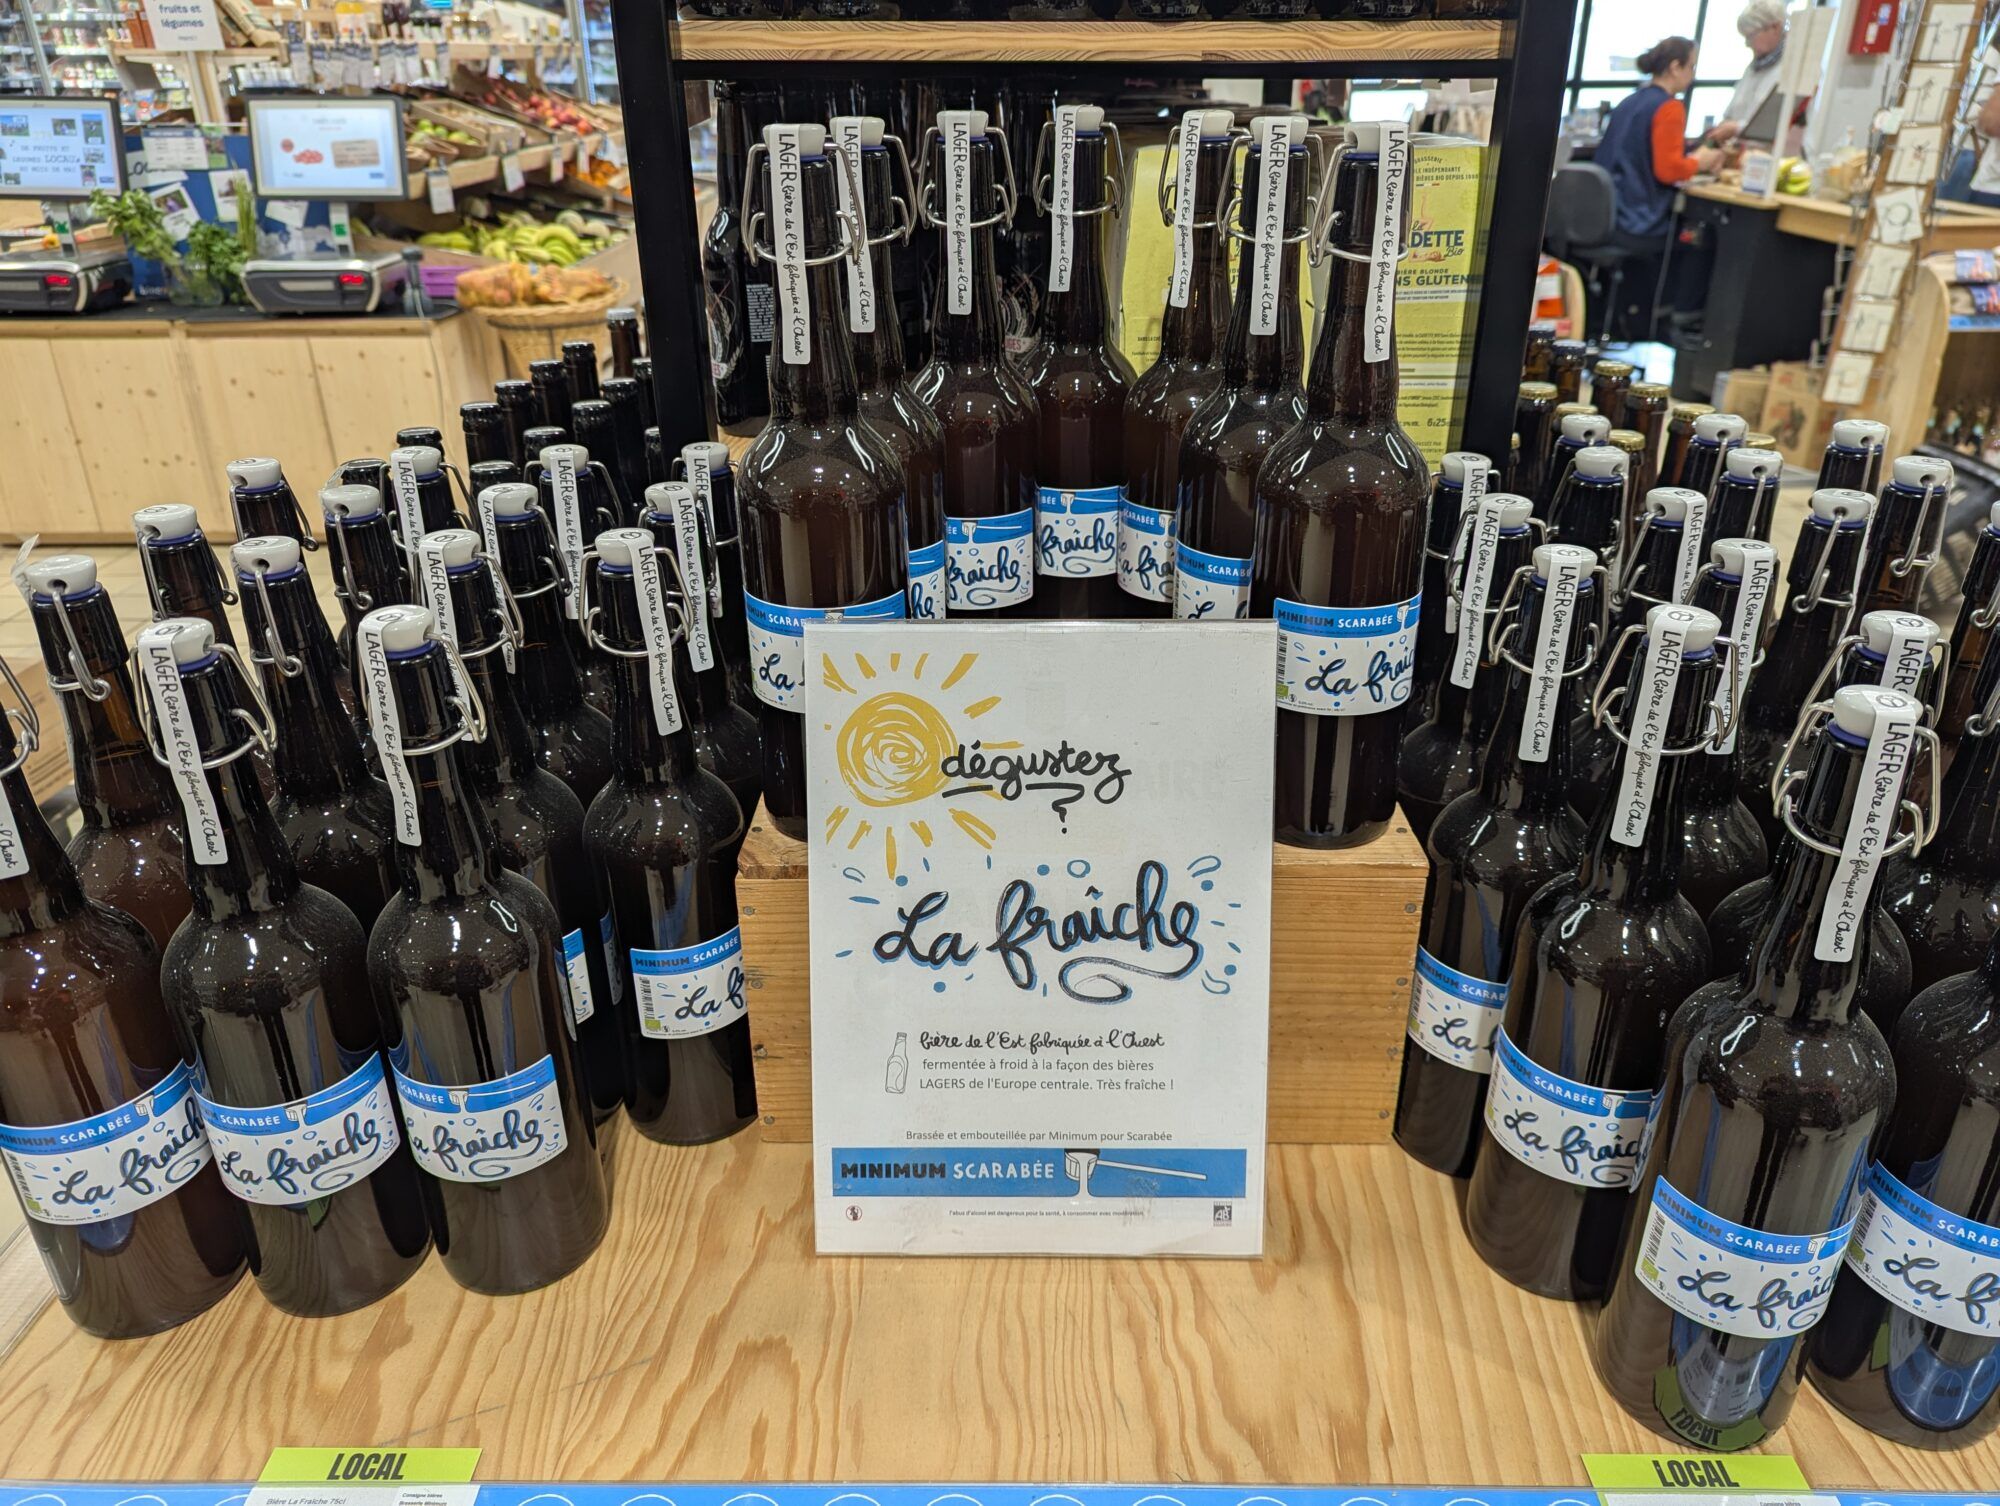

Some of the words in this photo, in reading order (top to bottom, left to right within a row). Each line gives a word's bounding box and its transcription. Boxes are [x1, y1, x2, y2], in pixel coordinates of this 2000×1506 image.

[953, 122, 967, 164] LAGER
[1061, 112, 1073, 152] LAGER
[1185, 118, 1200, 160] LAGER
[1268, 124, 1286, 172] LAGER
[779, 133, 796, 185] LAGER
[1386, 130, 1403, 181] LAGER
[781, 185, 794, 215] bière
[1385, 181, 1397, 212] bière
[784, 217, 794, 230] de
[1384, 215, 1392, 227] de
[1410, 230, 1465, 248] DETTE
[785, 233, 797, 261] l'Est
[1381, 230, 1393, 258] l'Est
[783, 264, 799, 304] fabriquée
[1374, 261, 1389, 302] fabriquée
[793, 316, 805, 356] l'Ouest
[1374, 314, 1387, 355] l'Ouest
[678, 497, 695, 536] LAGER
[1479, 509, 1496, 550] LAGER
[638, 546, 656, 589] LAGER
[1747, 560, 1768, 601] LAGER
[1554, 566, 1575, 610] LAGER
[1338, 615, 1393, 628] SCARABÉE
[150, 647, 177, 696] LAGER
[365, 632, 385, 678] LAGER
[760, 653, 795, 690] La
[1654, 630, 1680, 680] LAGER
[1305, 658, 1359, 696] La
[1651, 679, 1668, 707] bière
[163, 695, 178, 724] bière
[1647, 709, 1659, 720] de
[172, 727, 183, 738] de
[1641, 723, 1658, 749] l'Est
[1876, 722, 1908, 776] LAGER
[176, 741, 192, 767] l'Est
[941, 740, 1132, 804] dégustez
[1632, 751, 1651, 788] fabriquée
[179, 770, 203, 806] fabriquée
[1871, 775, 1892, 806] bière
[1625, 800, 1645, 837] l'Ouest
[1866, 810, 1880, 823] de
[201, 817, 218, 856] l'Ouest
[1858, 826, 1879, 856] l'Est
[1842, 859, 1868, 898] fabriquée
[873, 891, 980, 968] La
[986, 860, 1203, 1004] fraîche
[1833, 911, 1855, 953] l'Ouest
[635, 956, 690, 968] MINIMUM
[693, 936, 739, 964] SCARABÉE
[675, 985, 722, 1020] La
[1462, 984, 1505, 1002] SCARAB
[920, 1031, 962, 1050] bière
[966, 1034, 984, 1048] de
[985, 1031, 1026, 1049] l'Est
[1030, 1032, 1092, 1055] fabriquée
[1094, 1036, 1104, 1048] à
[1106, 1029, 1166, 1048] l'Ouest
[1432, 1017, 1478, 1052] La
[920, 1078, 965, 1089] LAGERS
[969, 1078, 983, 1089] de
[988, 1078, 1036, 1091] l'Europe
[1041, 1079, 1092, 1090] centrale.
[1096, 1079, 1121, 1090] Très
[1125, 1078, 1166, 1090] fraîche
[923, 1059, 985, 1070] fermentée
[990, 1059, 996, 1070] à
[1000, 1059, 1027, 1070] froid
[1032, 1059, 1038, 1070] à
[1043, 1059, 1052, 1070] la
[1056, 1059, 1088, 1073] façon
[1093, 1059, 1113, 1070] des
[1118, 1060, 1154, 1071] bières
[400, 1081, 445, 1105] SCARABÉE
[1534, 1076, 1597, 1106] SCARABÉE
[60, 1113, 133, 1145] SCARABÉE
[220, 1114, 281, 1128] SCARABÉE
[907, 1130, 944, 1140] Brassée
[948, 1132, 957, 1140] et
[960, 1130, 1026, 1140] embouteillée
[1029, 1132, 1046, 1143] par
[1049, 1131, 1097, 1141] Minimum
[1101, 1133, 1124, 1143] pour
[1127, 1131, 1172, 1141] Scarabée
[1504, 1109, 1549, 1152] La
[220, 1151, 262, 1186] La
[266, 1112, 382, 1195] fraîche
[432, 1110, 544, 1178] fraîche
[52, 1169, 115, 1206] La
[841, 1163, 946, 1179] MINIMUM
[953, 1159, 1054, 1180] SCARABÉE
[1658, 1187, 1722, 1238] MINIMUM
[1725, 1232, 1802, 1255] SCARABÉE
[1872, 1169, 1934, 1223] MINIMUM
[1936, 1219, 2000, 1248] SCARAB
[1677, 1268, 1745, 1312] La
[1883, 1252, 1952, 1302] La
[326, 1453, 407, 1480] LOCAL
[1652, 1460, 1740, 1488] LOCAL
